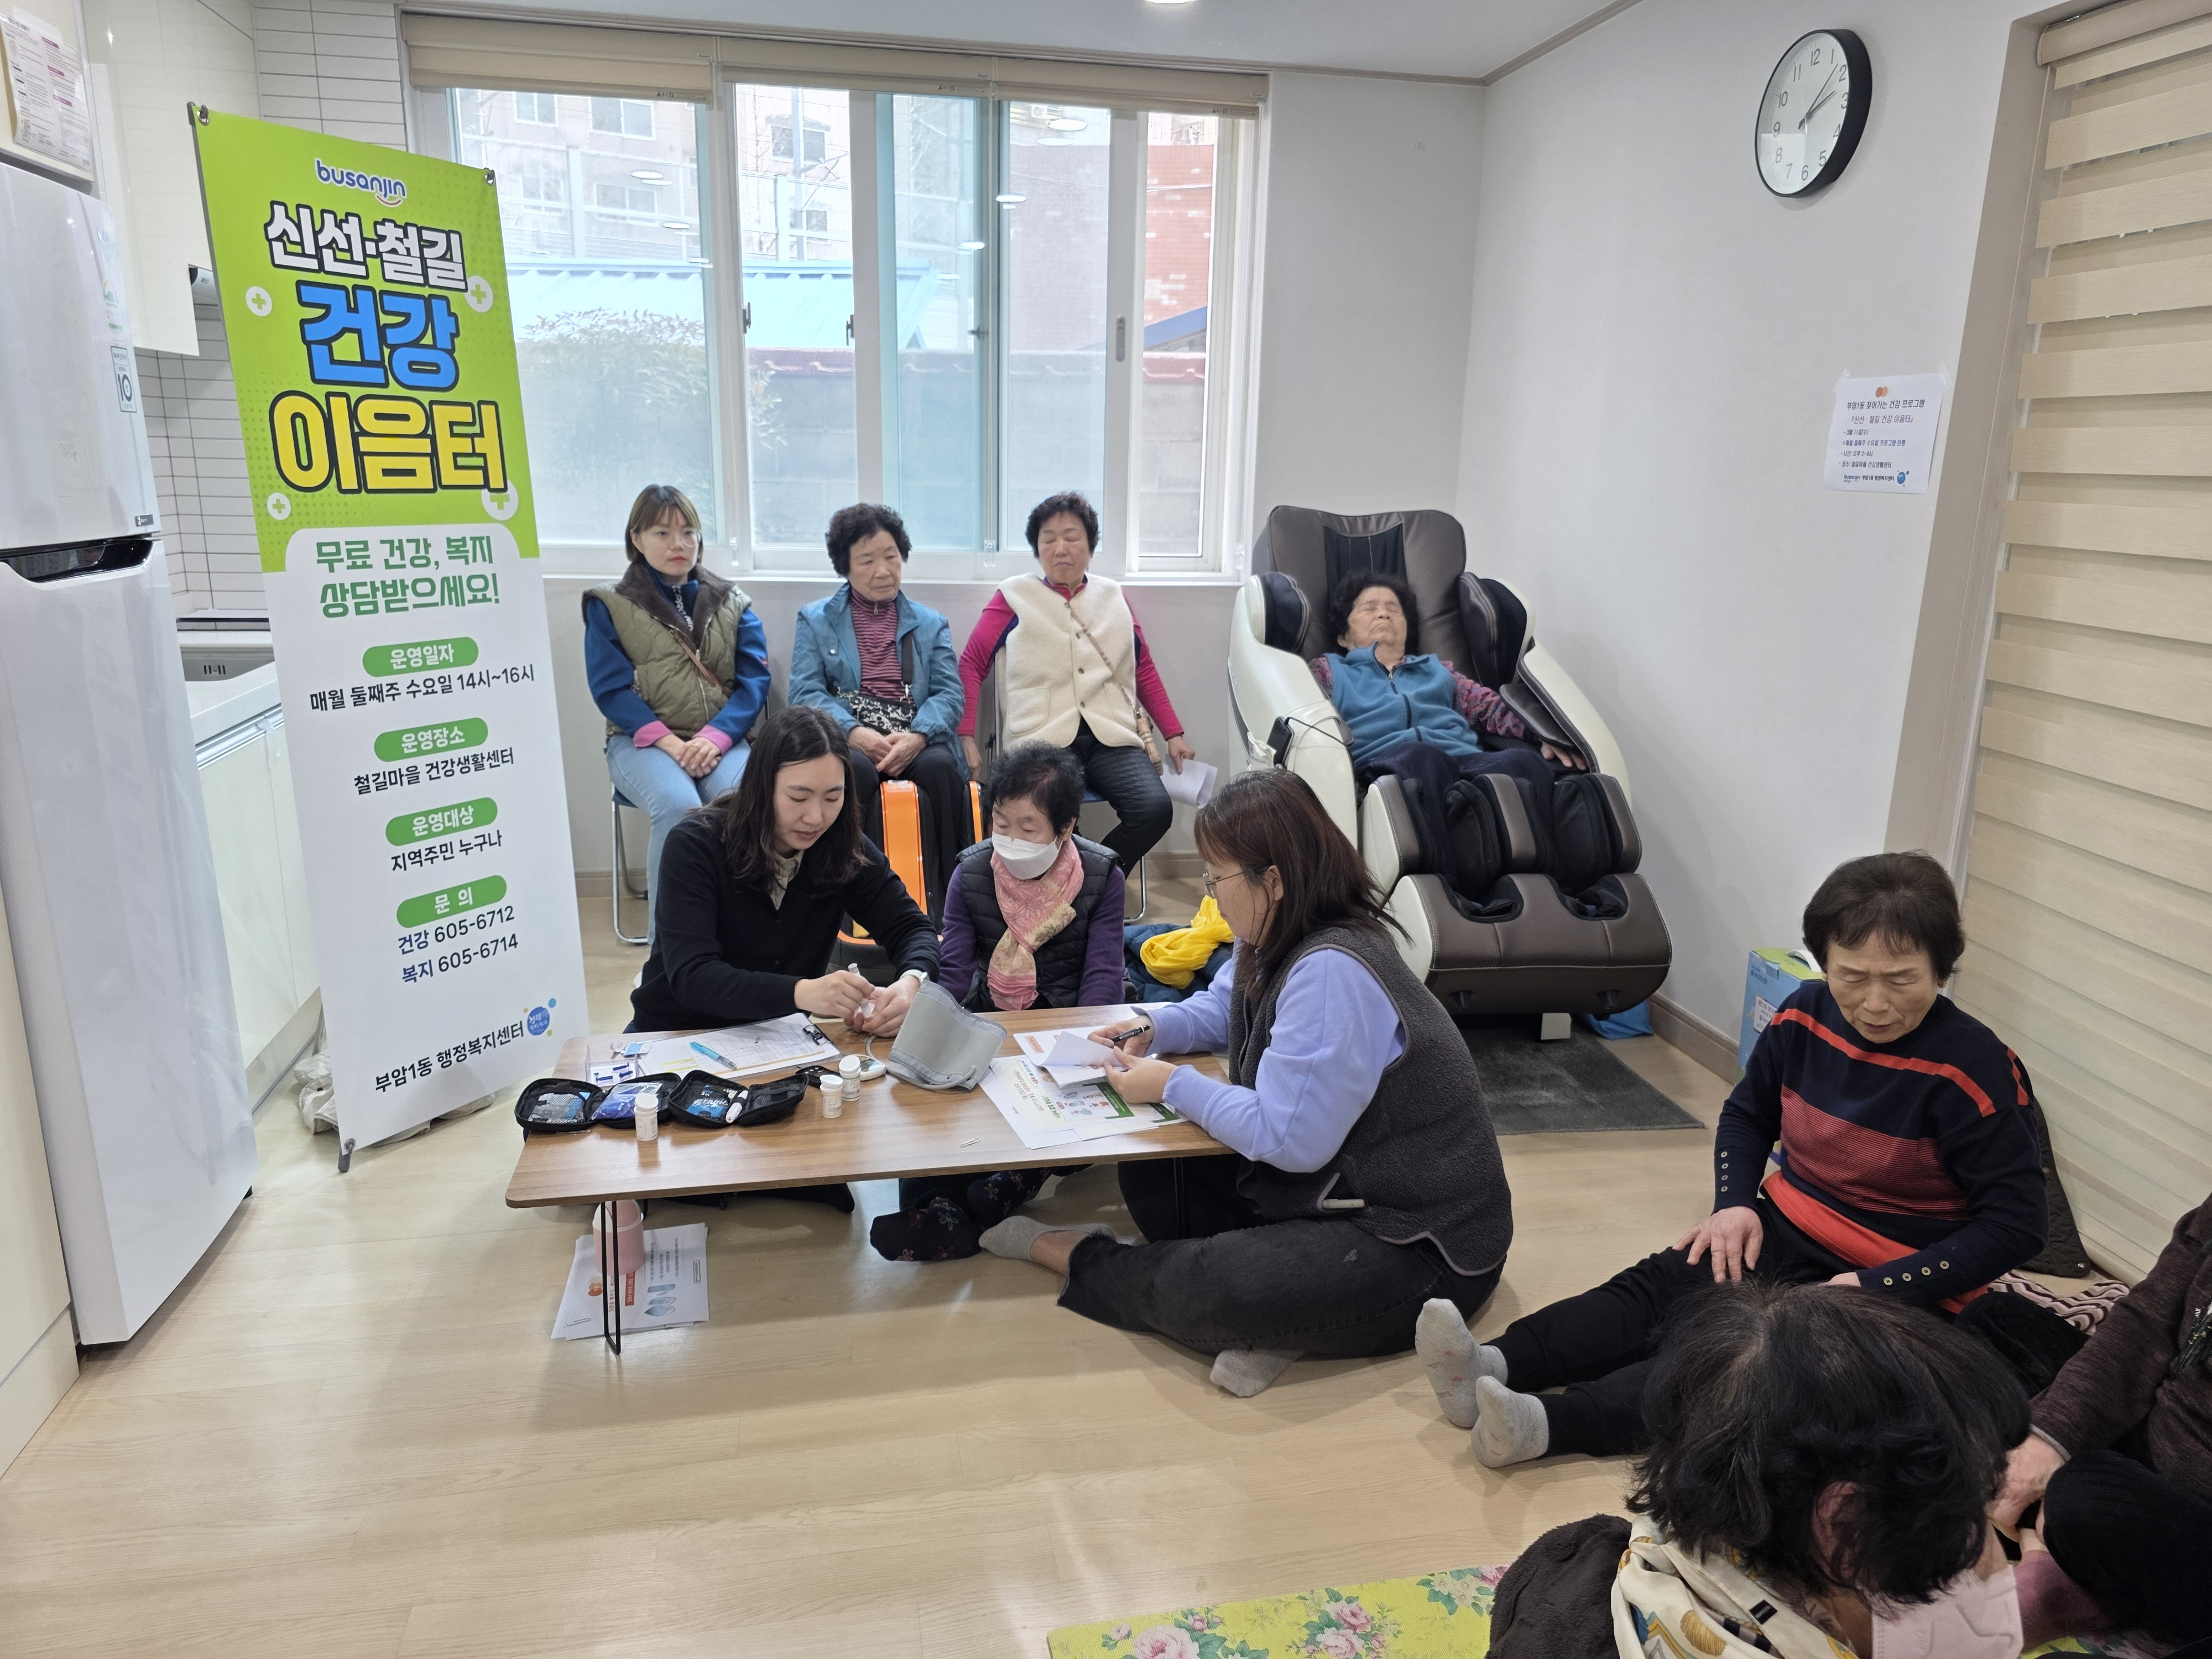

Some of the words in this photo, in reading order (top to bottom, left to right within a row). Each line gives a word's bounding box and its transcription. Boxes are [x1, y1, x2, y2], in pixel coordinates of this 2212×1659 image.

[1810, 48, 1820, 67] 12
[1830, 48, 1834, 65] 1
[1793, 64, 1802, 82] 11
[1839, 64, 1847, 82] 2
[1777, 91, 1788, 109] 10
[1840, 92, 1848, 109] 3
[1773, 121, 1781, 137] 9
[1833, 123, 1840, 138] 4
[1775, 147, 1782, 164] 8
[1819, 150, 1827, 167] 5
[315, 159, 406, 199] busanjin
[1786, 163, 1793, 179] 7
[1801, 165, 1809, 181] 6
[264, 201, 468, 291] 신선·철길
[296, 280, 460, 392] 건강
[117, 373, 132, 402] 10
[1847, 401, 1865, 410] 부암1동
[1866, 401, 1887, 410] 찾아가는
[1889, 400, 1901, 409] 건강
[1902, 399, 1925, 408] 프로그램
[1869, 415, 1880, 424] 철길
[1881, 415, 1892, 424] 건강
[269, 390, 509, 494] 이음터
[316, 539, 373, 573] 무료
[379, 537, 440, 570] 건강,
[445, 535, 493, 566] 복지
[320, 573, 500, 618] 상담받으세요!
[389, 644, 455, 670] 운영일자
[310, 688, 346, 712] 매월
[350, 681, 402, 707] 둘째주
[405, 675, 453, 698] 수요일
[456, 664, 535, 691] 14시~16시
[400, 726, 465, 754] 운영장소
[354, 765, 421, 795] 철길마을
[425, 747, 515, 781] 건강생활센터
[411, 806, 474, 837] 운영대상
[391, 841, 455, 872] 지역주민
[458, 829, 503, 858] 누구나
[397, 930, 429, 956] 건강
[434, 905, 515, 944] 605-6712
[401, 959, 434, 984] 복지
[437, 932, 519, 973] 605-6714
[374, 1056, 433, 1093] 부암1동
[436, 1020, 524, 1070] 행정복지센터
